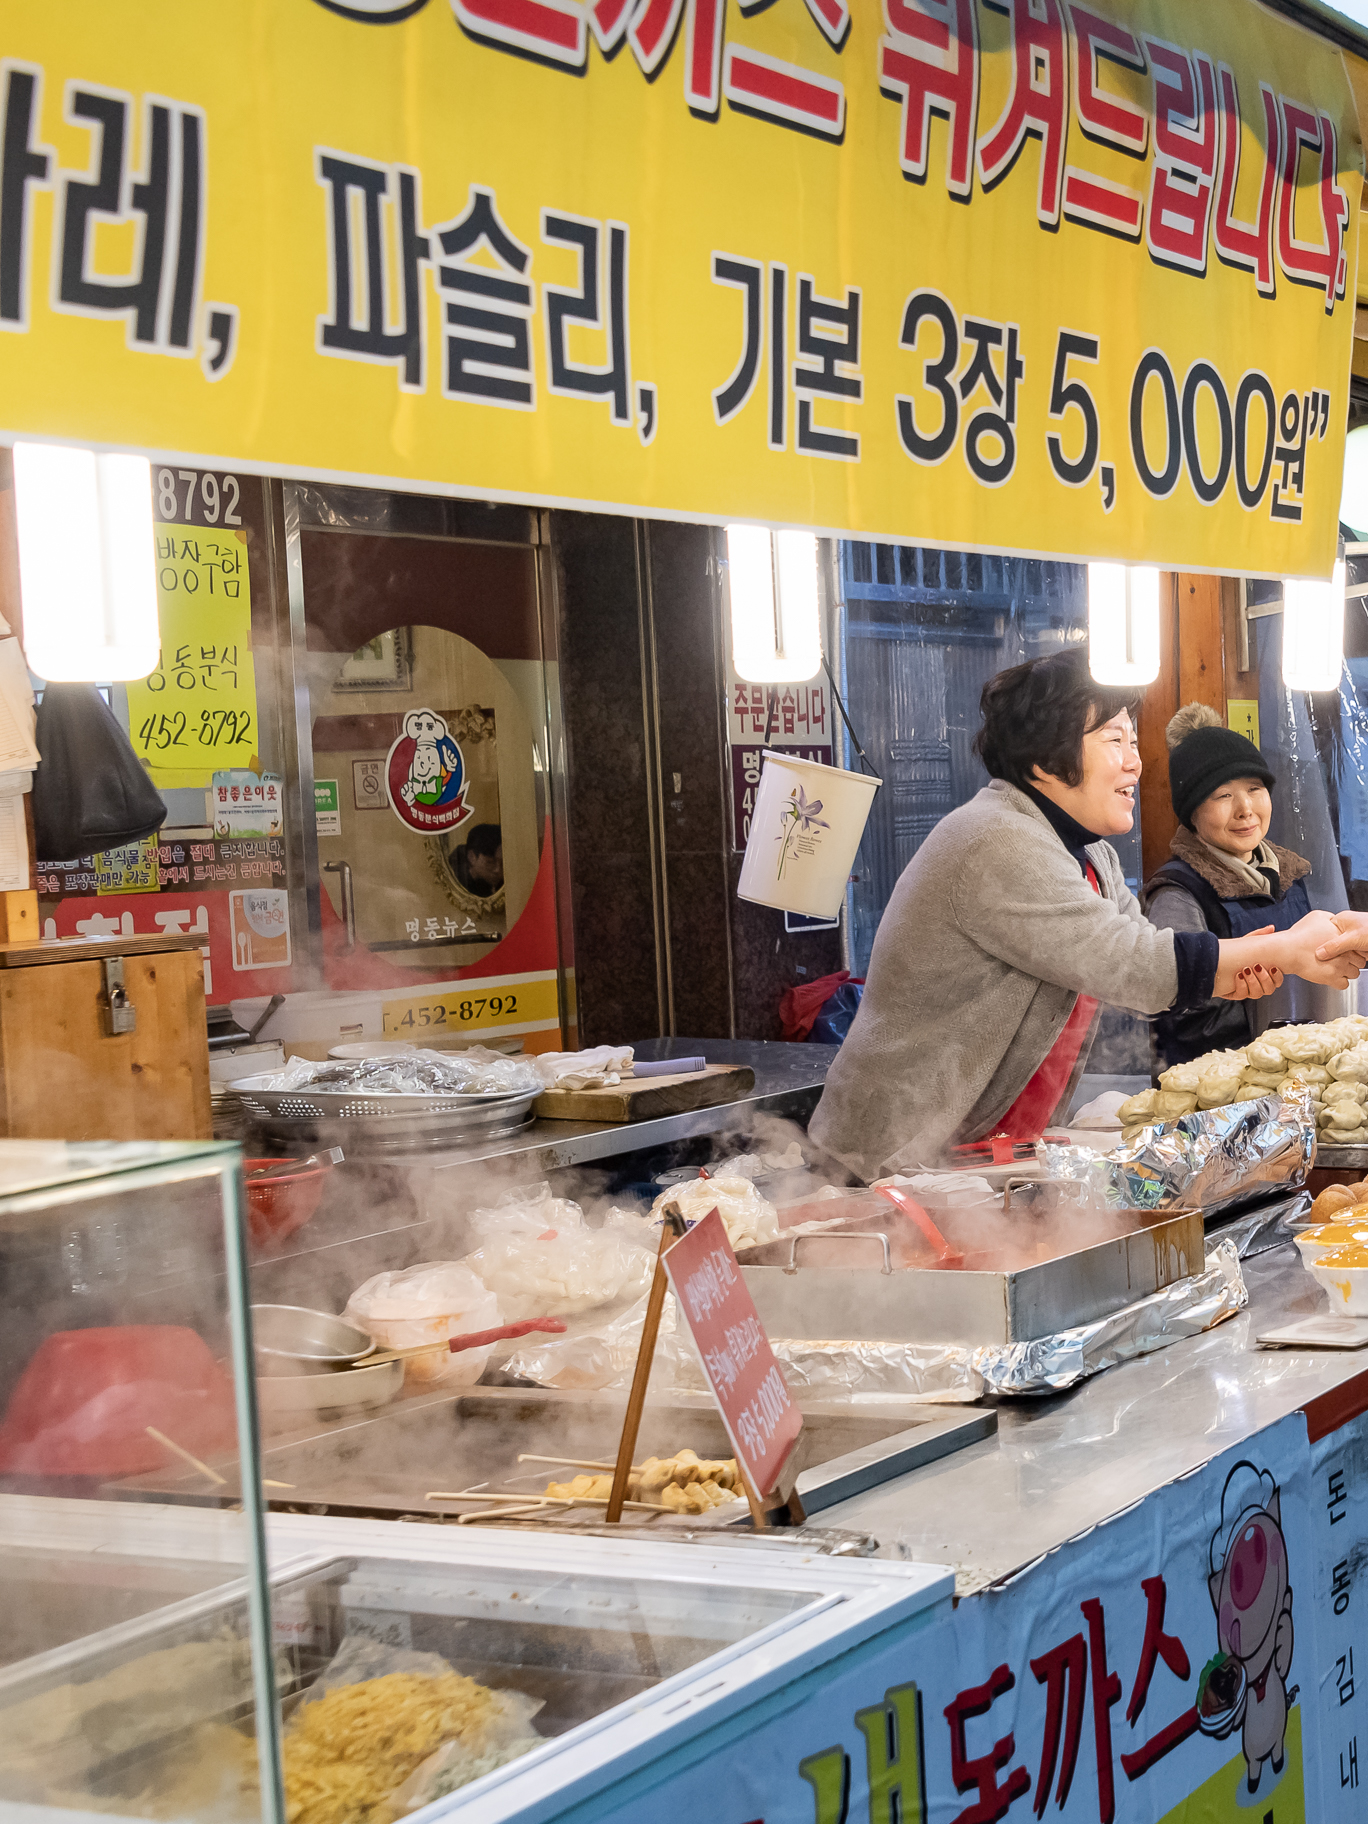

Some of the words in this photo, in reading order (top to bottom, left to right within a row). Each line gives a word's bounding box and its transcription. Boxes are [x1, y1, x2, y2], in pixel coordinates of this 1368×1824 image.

[313, 145, 656, 447] 파슬리,
[711, 250, 862, 463] 기본
[897, 288, 1025, 486] 3장
[138, 708, 254, 751] 452-8792
[733, 683, 826, 735] 주문받습니다
[190, 842, 215, 863] 절대
[220, 839, 286, 861] 금지합니다.
[405, 916, 478, 942] 명동뉴스
